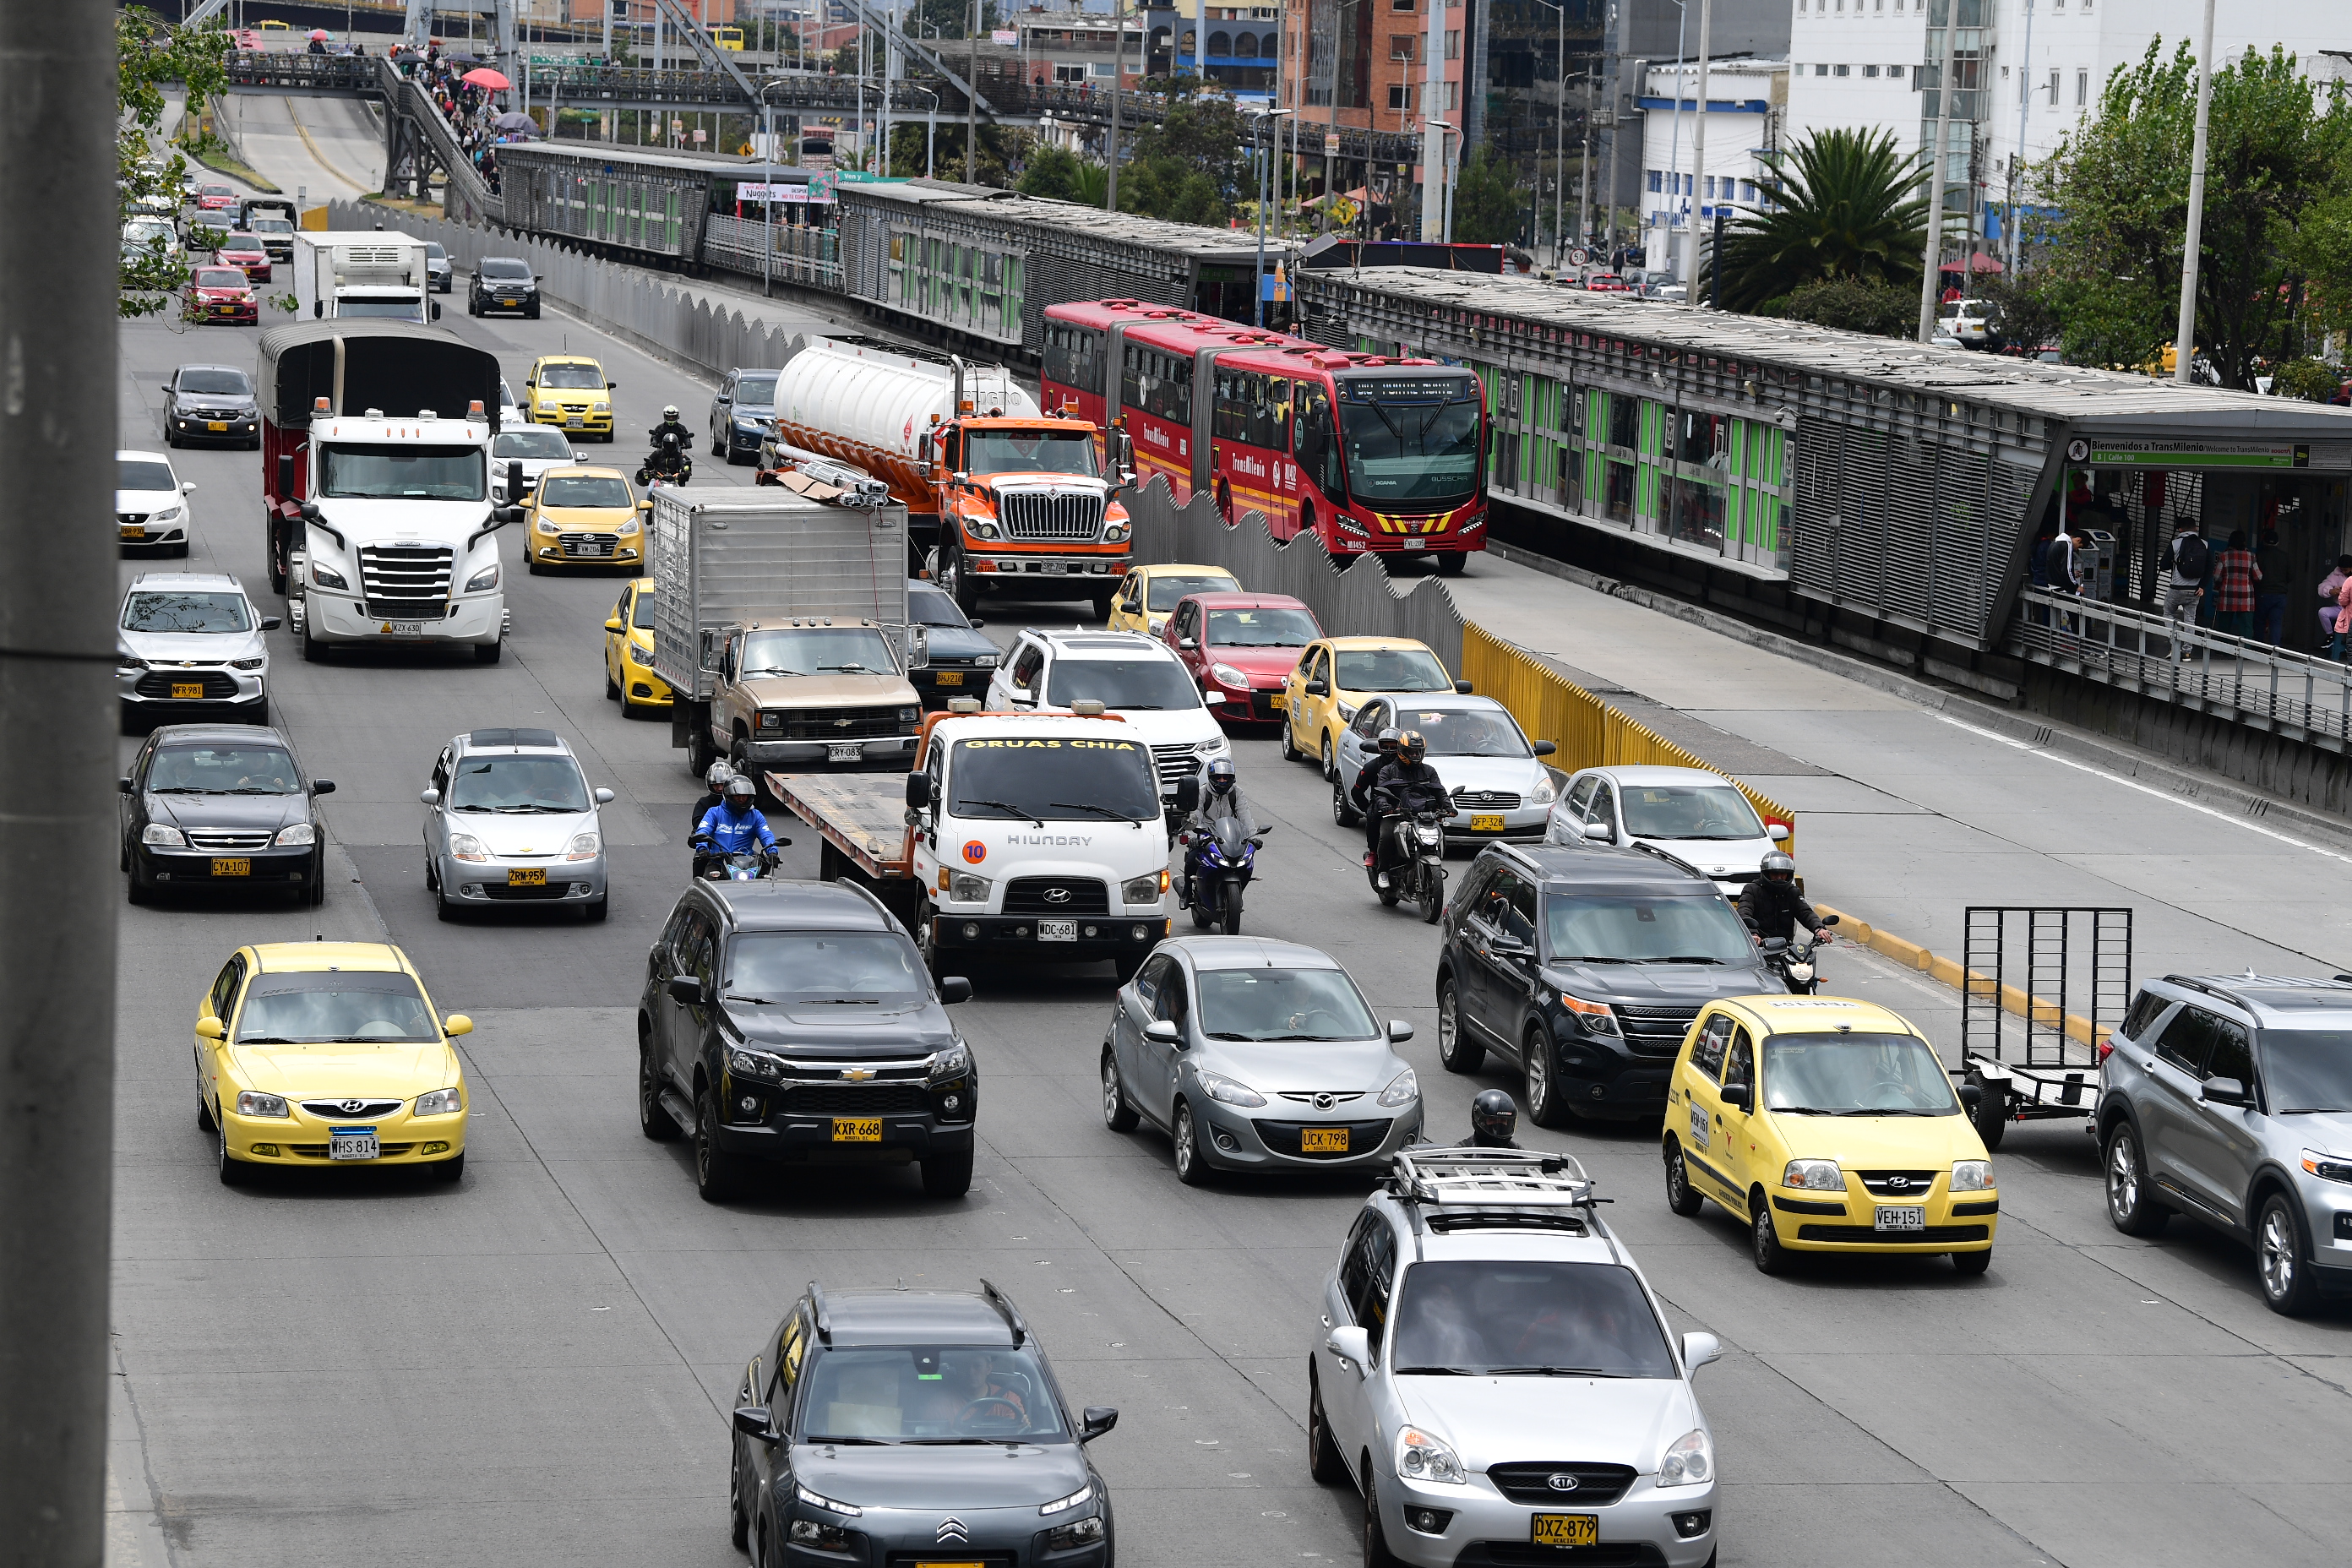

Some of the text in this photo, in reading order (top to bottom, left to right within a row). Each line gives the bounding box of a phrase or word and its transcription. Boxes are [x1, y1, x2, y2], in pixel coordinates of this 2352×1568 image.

[746, 189, 776, 199] Nuggts
[1574, 253, 1584, 262] 50
[1022, 444, 1029, 454] 3
[2092, 441, 2143, 451] Bienvenidos
[1233, 453, 1265, 478] TransMilenio
[964, 739, 1135, 752] GRUAS CHIA
[1007, 835, 1092, 847] HIUNDAY
[966, 844, 983, 859] 10
[1553, 1478, 1573, 1487] KIA
